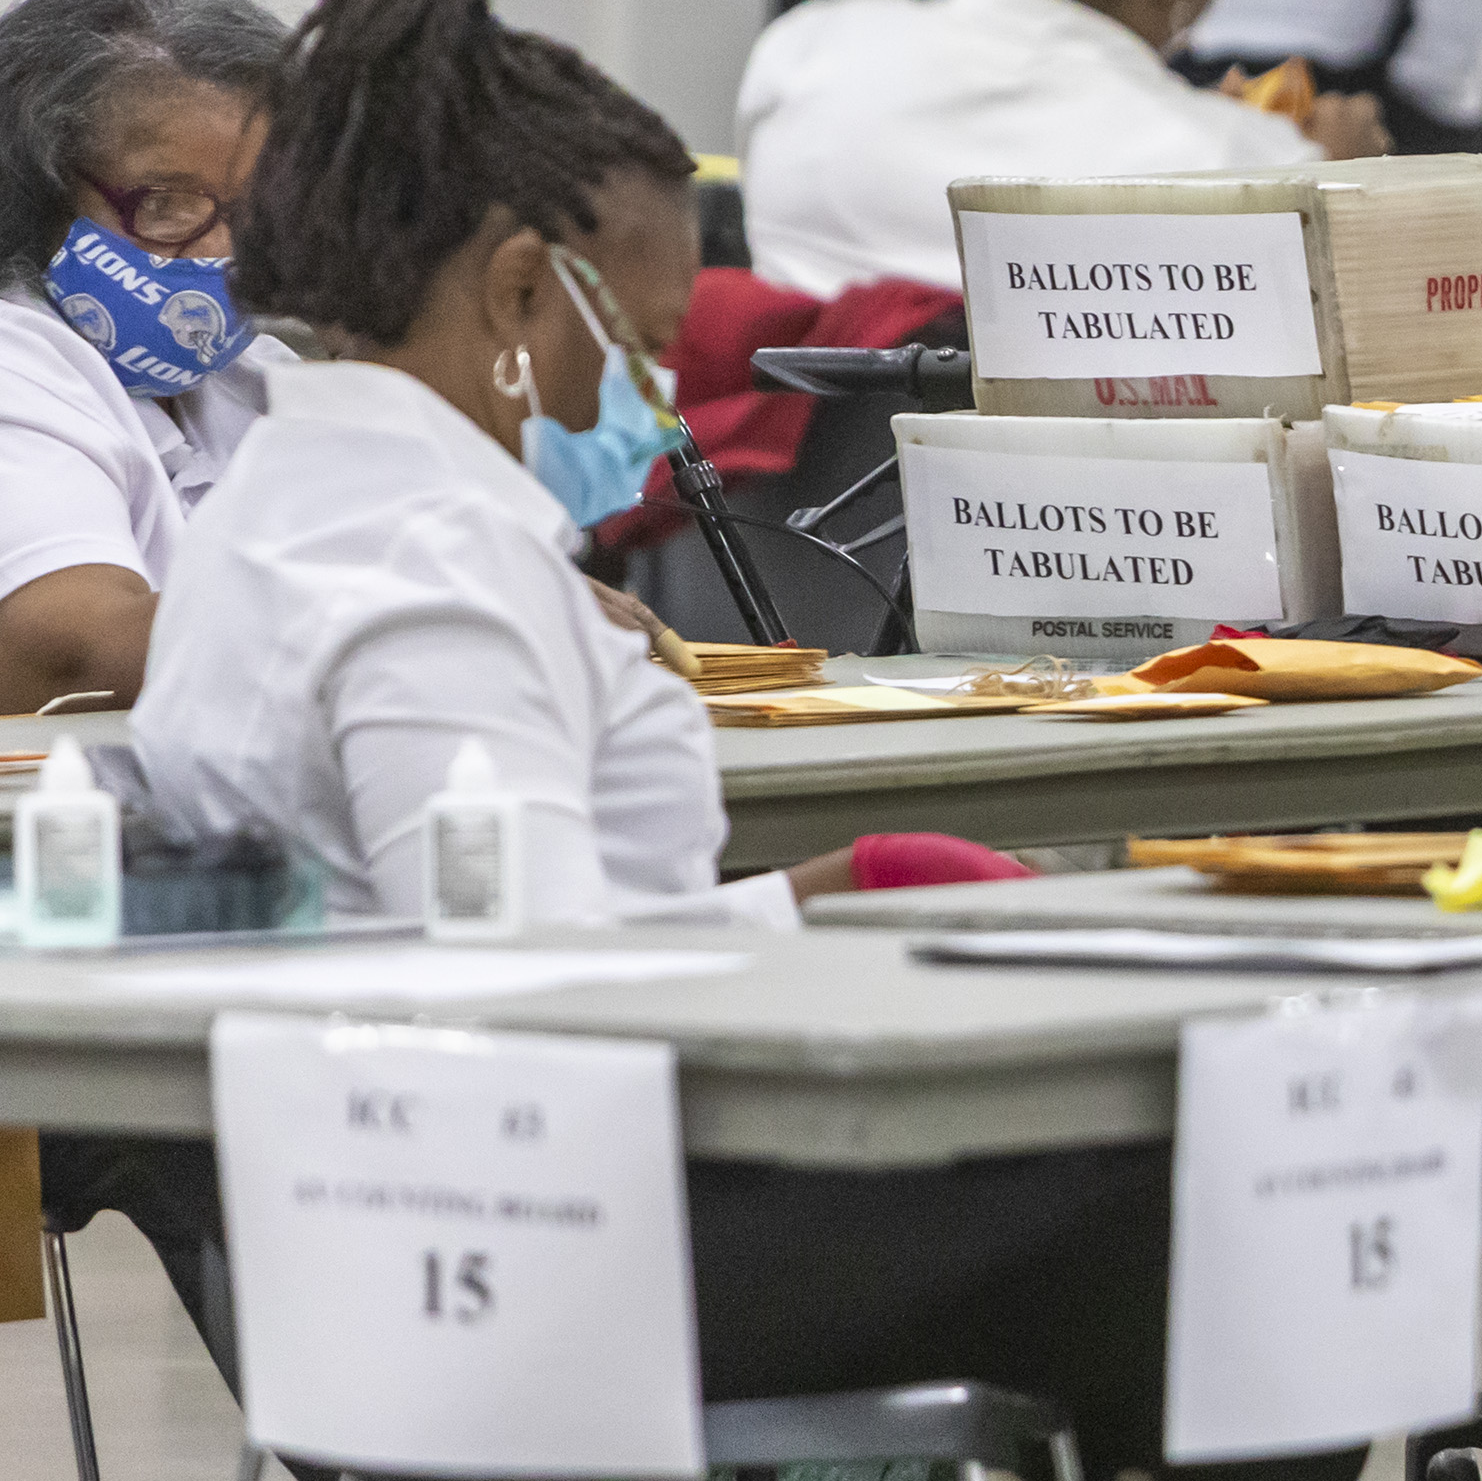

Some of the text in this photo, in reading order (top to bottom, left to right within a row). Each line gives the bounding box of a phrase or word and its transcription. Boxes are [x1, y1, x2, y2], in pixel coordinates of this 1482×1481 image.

[72, 233, 172, 305] LIONS
[1006, 262, 1257, 292] BALLOTS TO BE
[1038, 311, 1235, 340] TABULATED
[952, 497, 1219, 538] BALLOTS TO BE
[984, 548, 1194, 585] TABULATED
[1032, 620, 1173, 639] POSTAL SERVICE
[422, 1248, 496, 1325] 15
